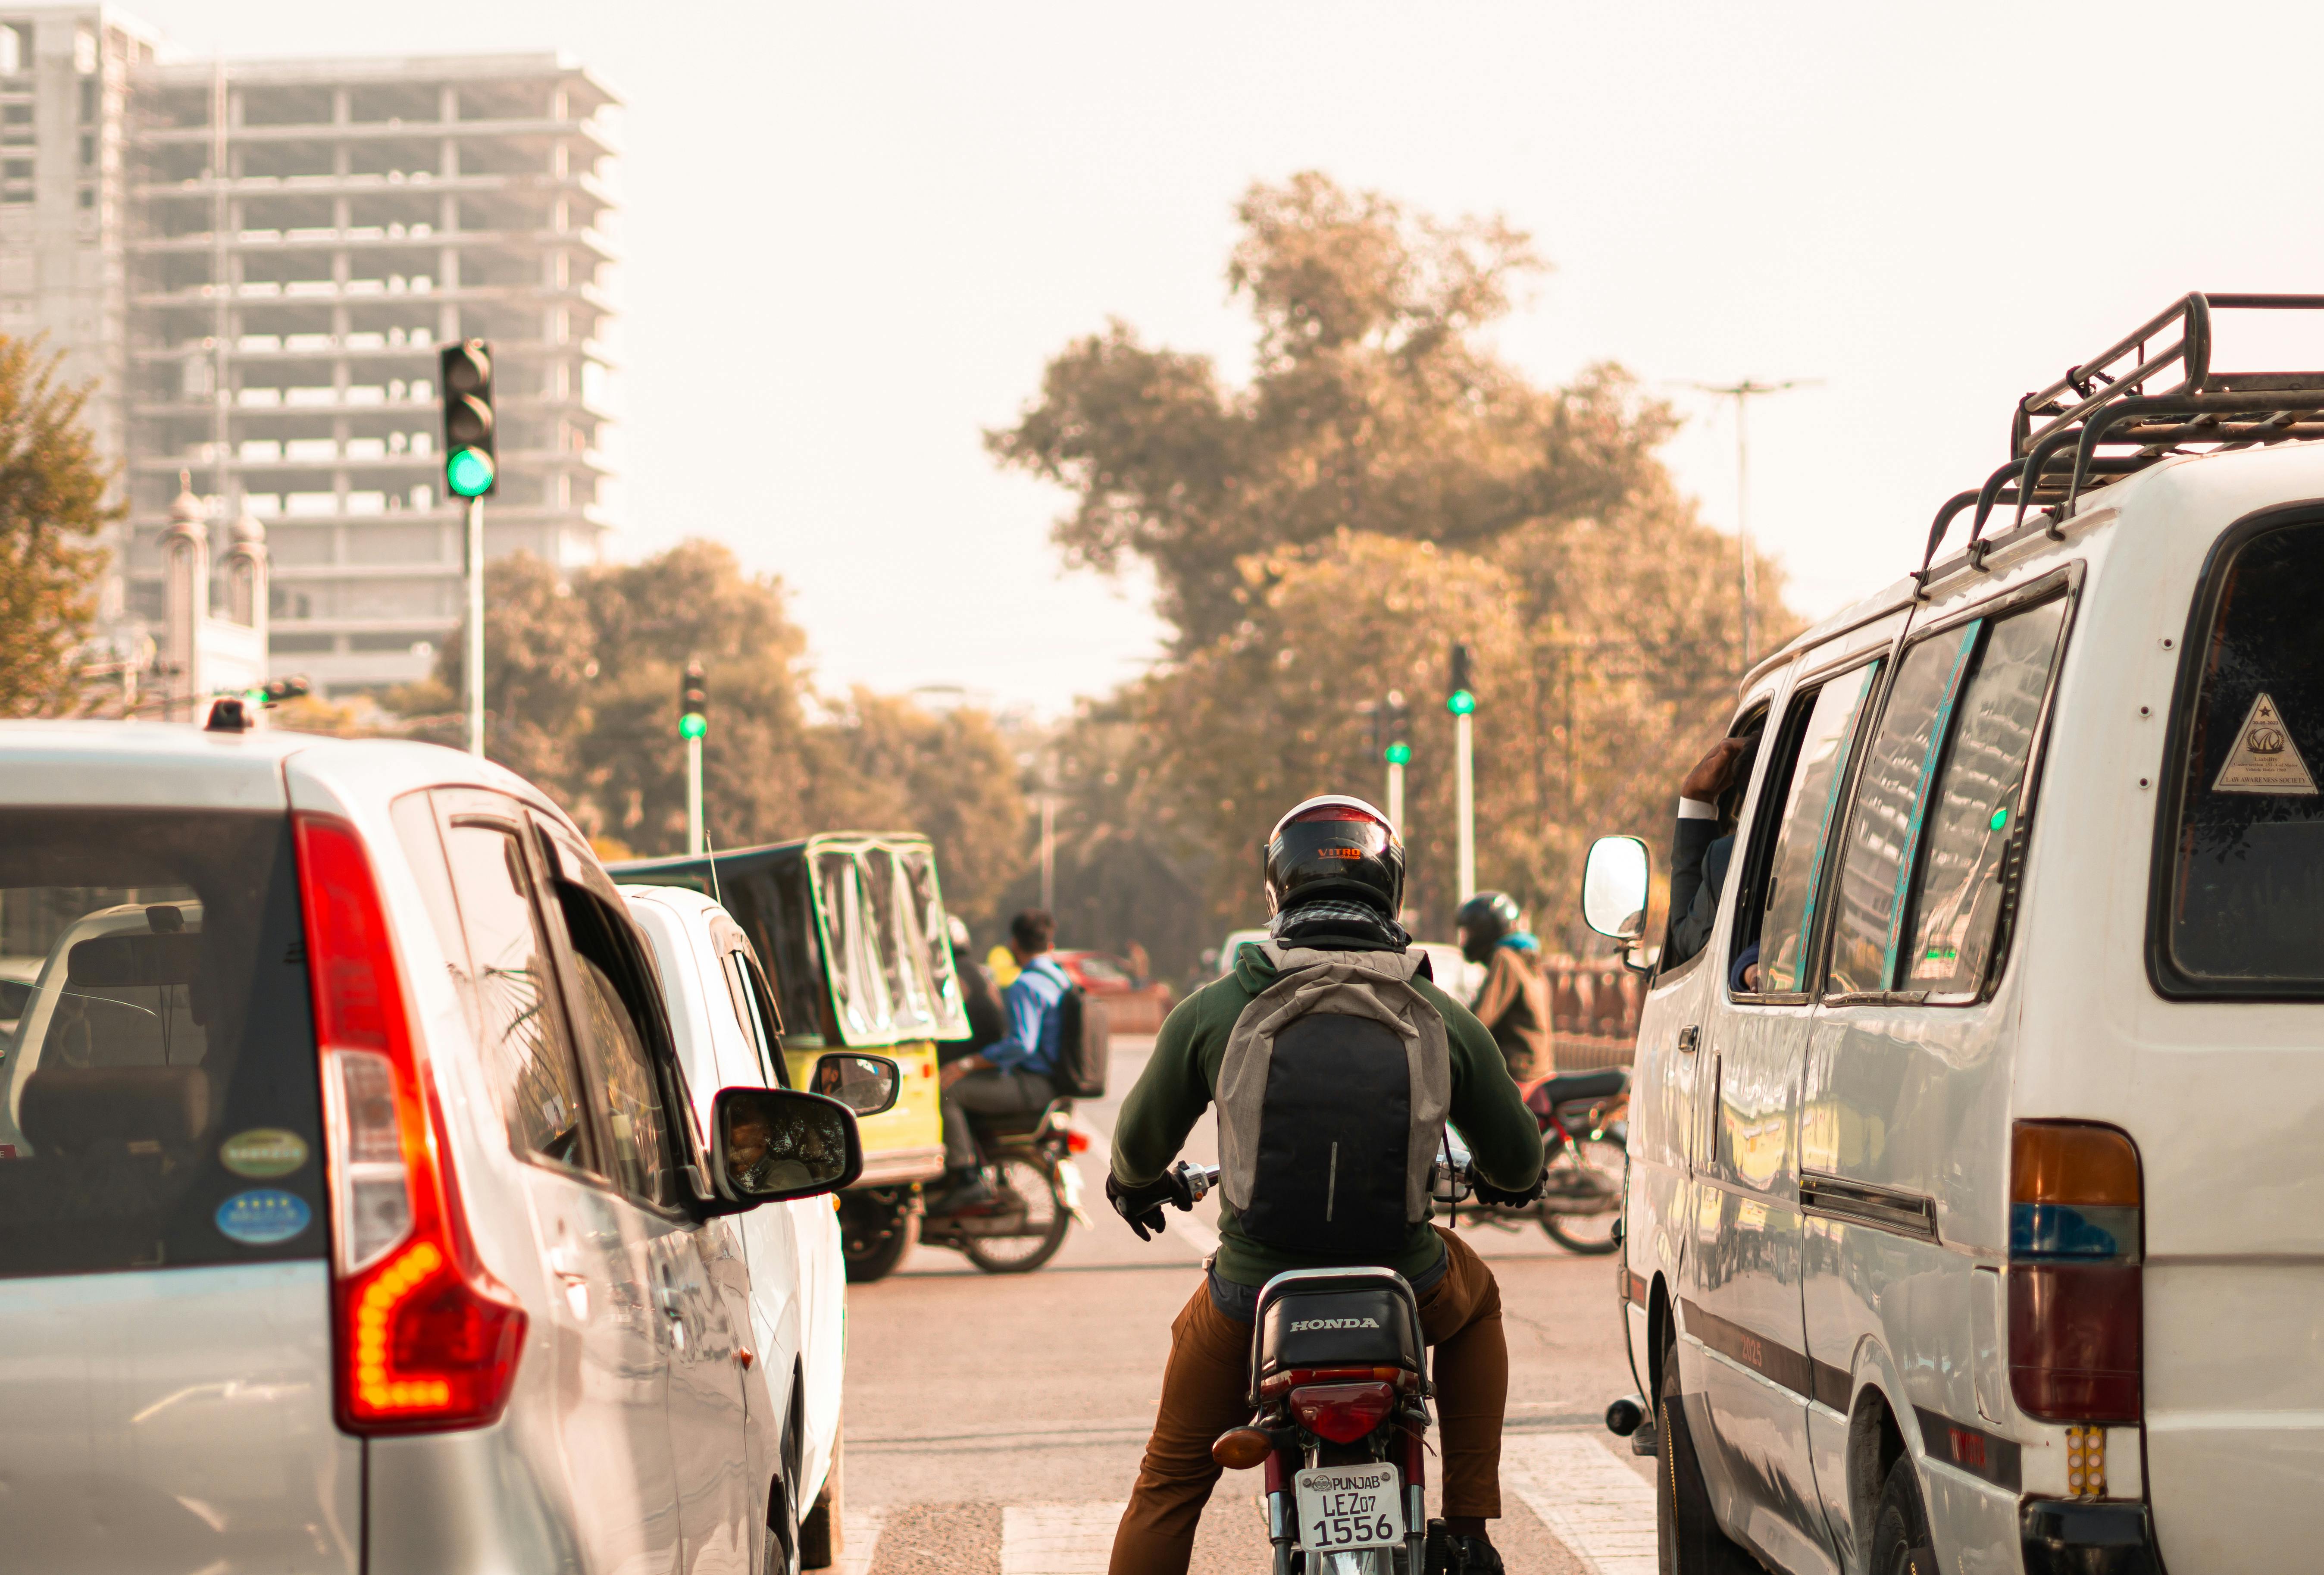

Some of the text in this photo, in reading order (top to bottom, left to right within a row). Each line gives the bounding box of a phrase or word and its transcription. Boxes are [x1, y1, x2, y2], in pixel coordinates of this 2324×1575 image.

[1318, 848, 1361, 857] VITRO
[1290, 1318, 1379, 1332] HONDA
[1741, 1334, 1762, 1367] 2025
[1332, 1475, 1380, 1490] PUNJAB
[1314, 1514, 1393, 1547] 1556
